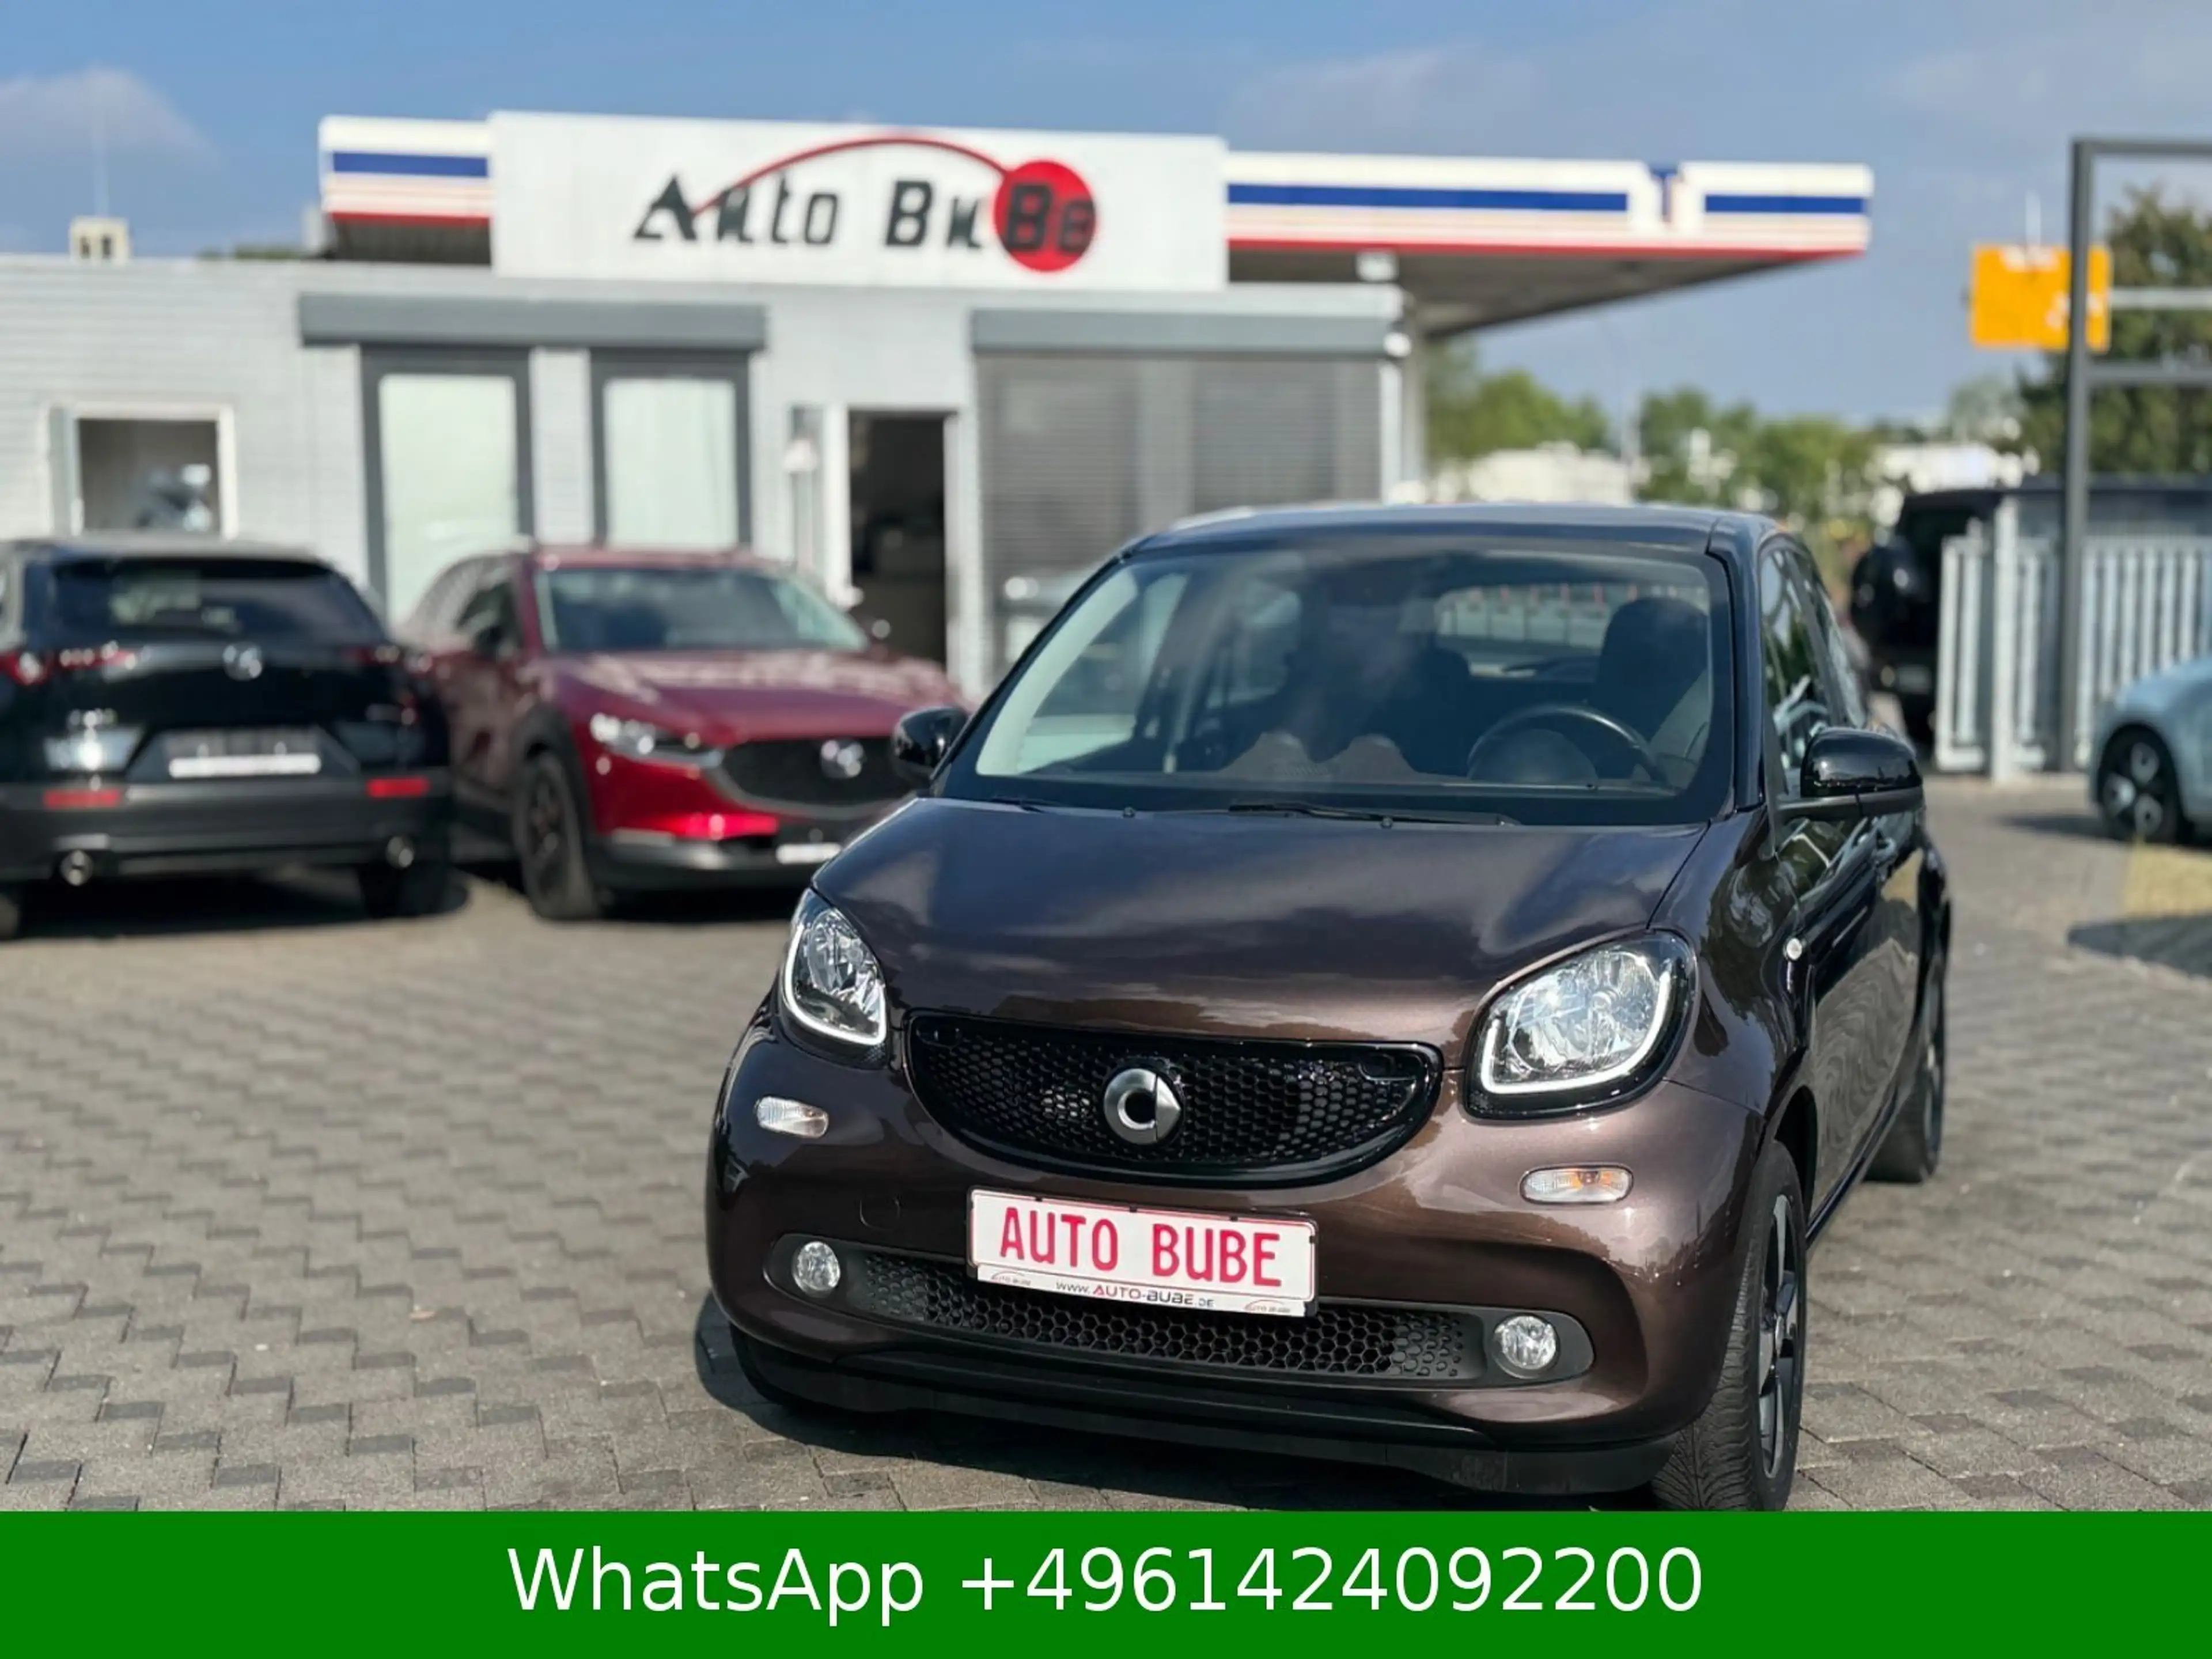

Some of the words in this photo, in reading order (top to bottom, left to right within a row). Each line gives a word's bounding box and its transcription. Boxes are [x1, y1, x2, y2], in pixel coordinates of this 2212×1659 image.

[634, 176, 839, 245] Auto
[1000, 1207, 1118, 1271] AUTO
[1152, 1222, 1282, 1288] BUBE
